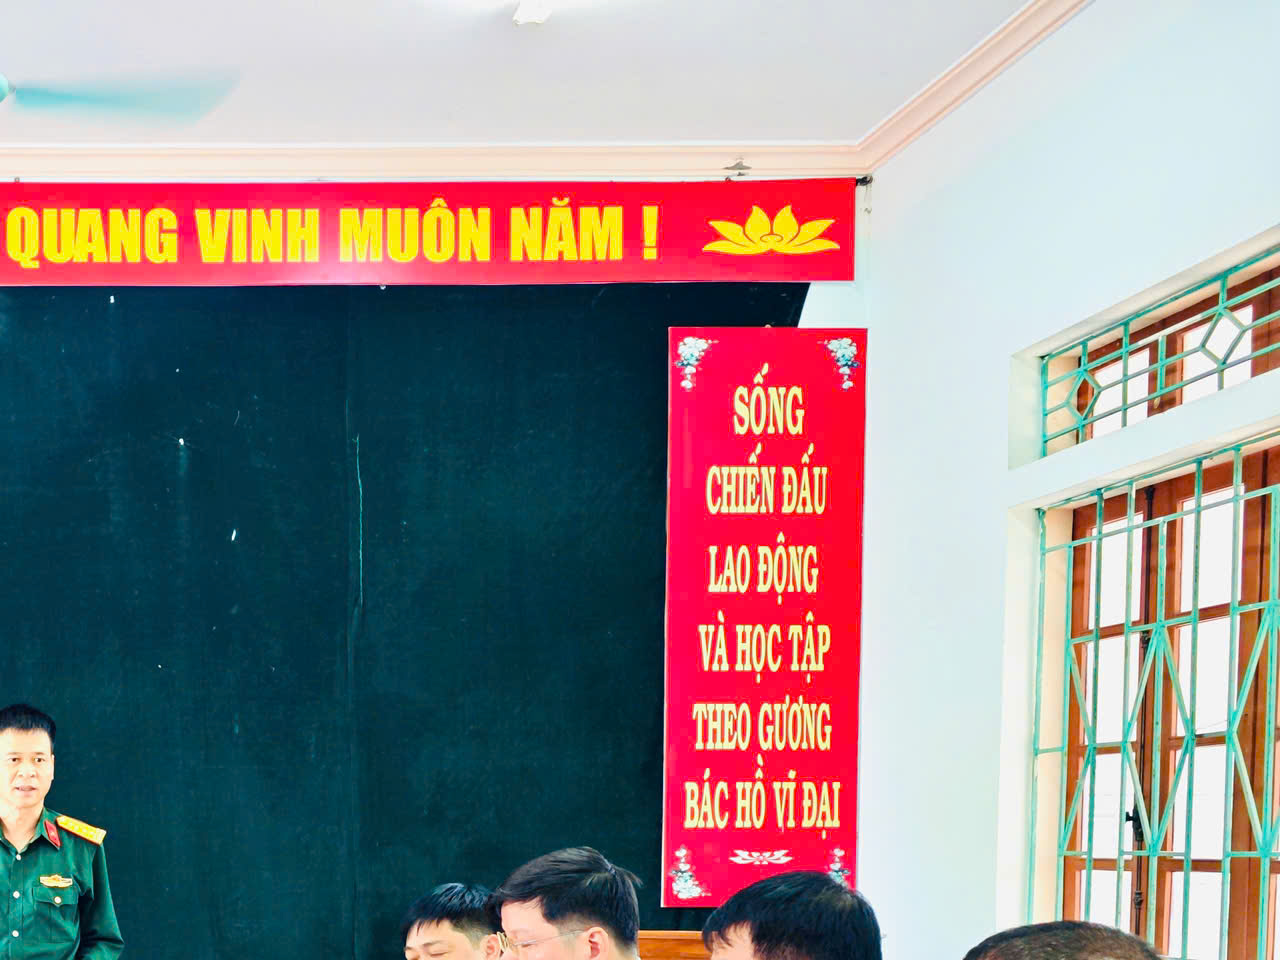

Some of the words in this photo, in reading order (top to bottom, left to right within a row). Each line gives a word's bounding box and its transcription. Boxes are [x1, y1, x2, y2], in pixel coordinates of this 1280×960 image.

[6, 206, 178, 269] QUANG
[194, 208, 321, 264] VINH
[338, 198, 491, 264] MUÔN
[510, 197, 623, 262] NĂM
[733, 362, 805, 435] SỐNG
[706, 442, 777, 515] CHIẾN
[781, 442, 828, 515] ĐẤU
[707, 544, 751, 594] LAO
[756, 531, 819, 605] ĐỘNG
[698, 610, 730, 672] VÀ
[735, 624, 782, 684] HỌC
[787, 611, 831, 684] TẬP
[692, 702, 751, 751] THEO
[757, 694, 833, 751] GƯƠNG
[683, 767, 729, 830] BÁC
[735, 753, 766, 829] HỒ
[772, 769, 797, 829] VĨ
[801, 781, 841, 840] ĐẠI
